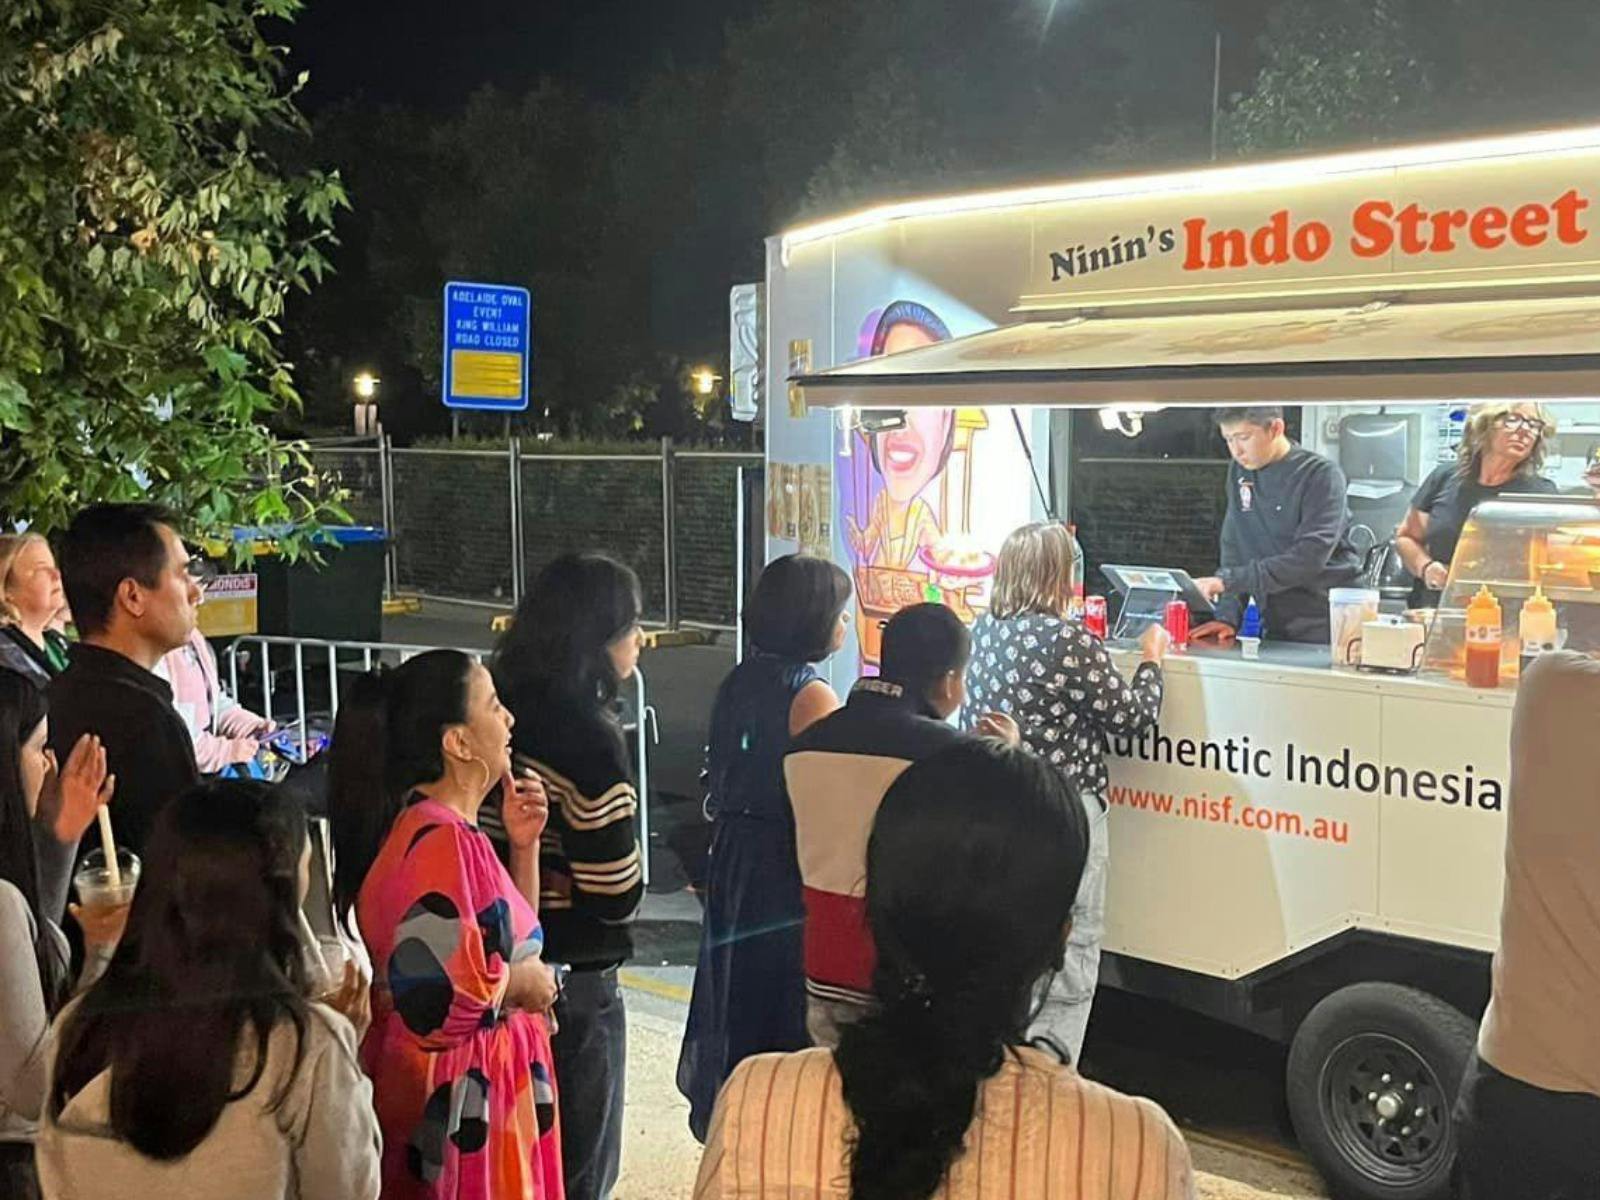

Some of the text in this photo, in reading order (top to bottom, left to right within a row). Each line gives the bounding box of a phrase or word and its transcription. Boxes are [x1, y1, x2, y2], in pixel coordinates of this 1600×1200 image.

[1049, 189, 1589, 281] Ninin's Indo Street
[501, 294, 522, 306] OVAL
[473, 306, 502, 318] EVENT
[456, 319, 519, 334] KING WILLIAM
[455, 334, 519, 347] ROAD CLOSED
[1101, 724, 1502, 811] uthentic Indonesia
[1107, 785, 1349, 843] www.nisf.com.au
